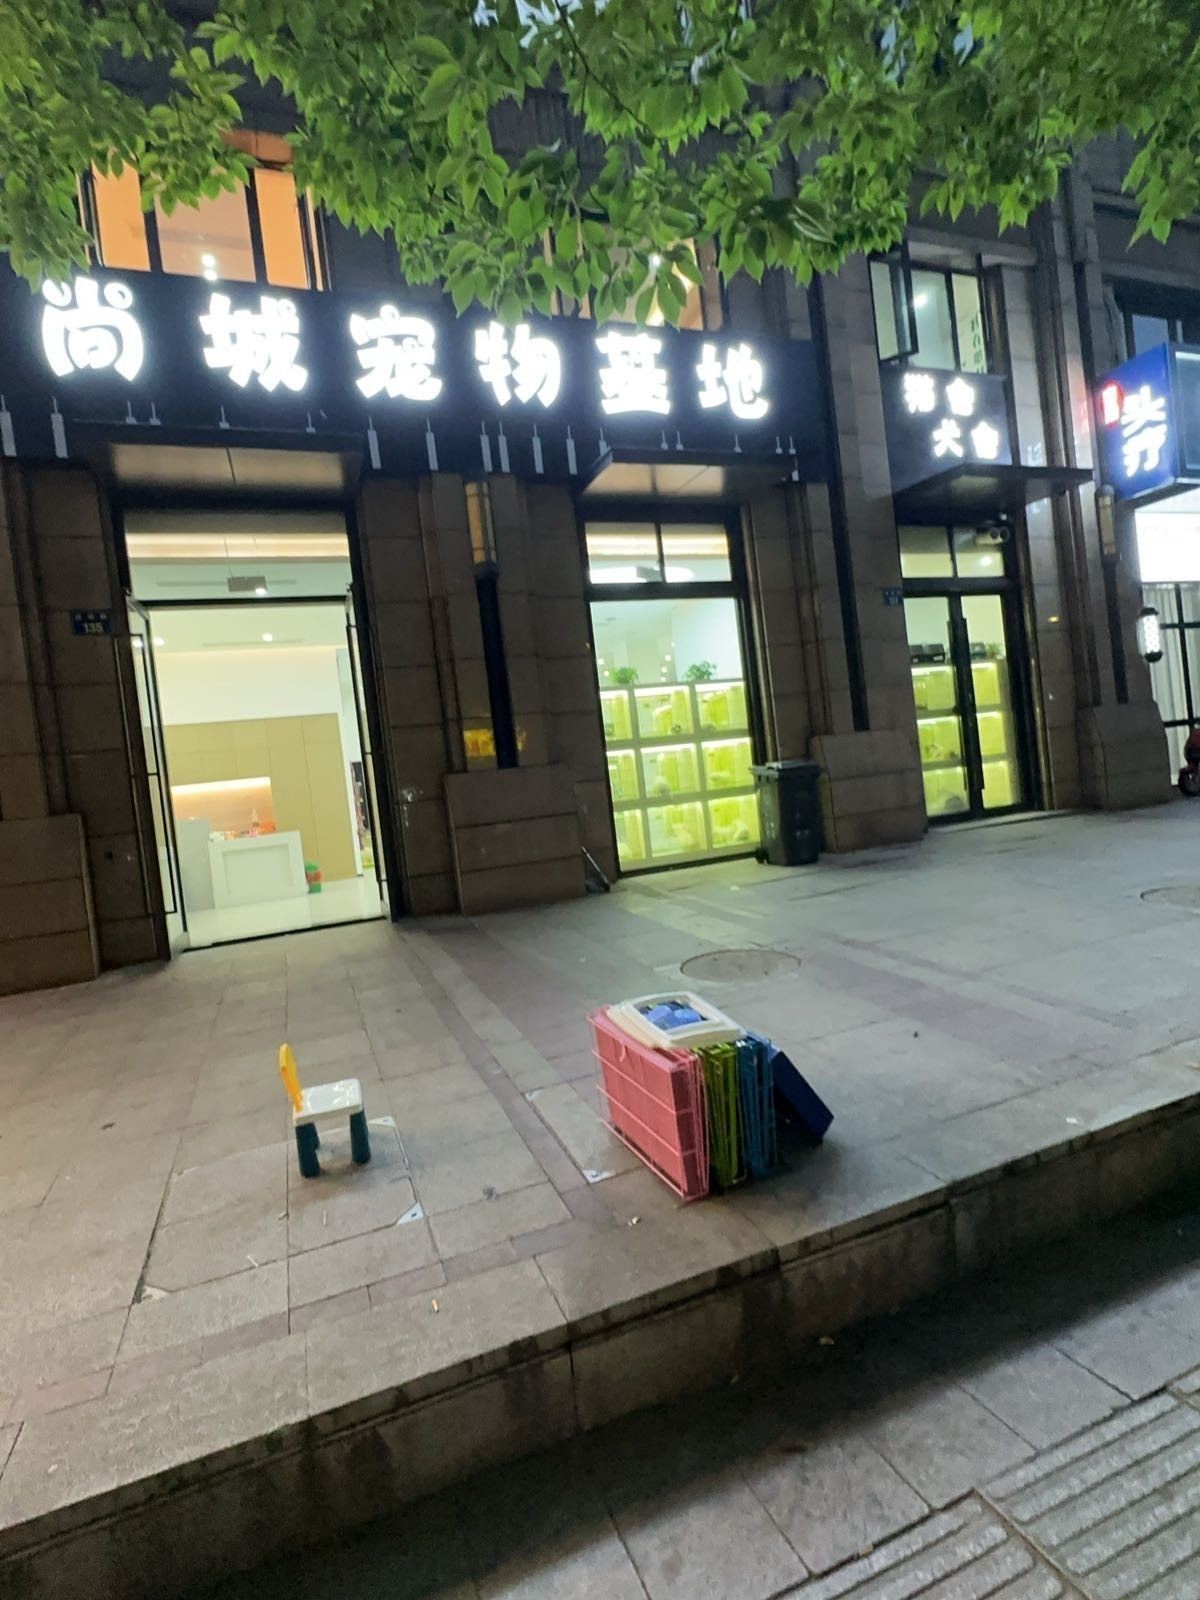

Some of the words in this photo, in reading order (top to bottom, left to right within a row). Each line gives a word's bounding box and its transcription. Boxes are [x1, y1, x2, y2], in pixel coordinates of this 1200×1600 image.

[41, 275, 770, 420] 尚城宠物基地
